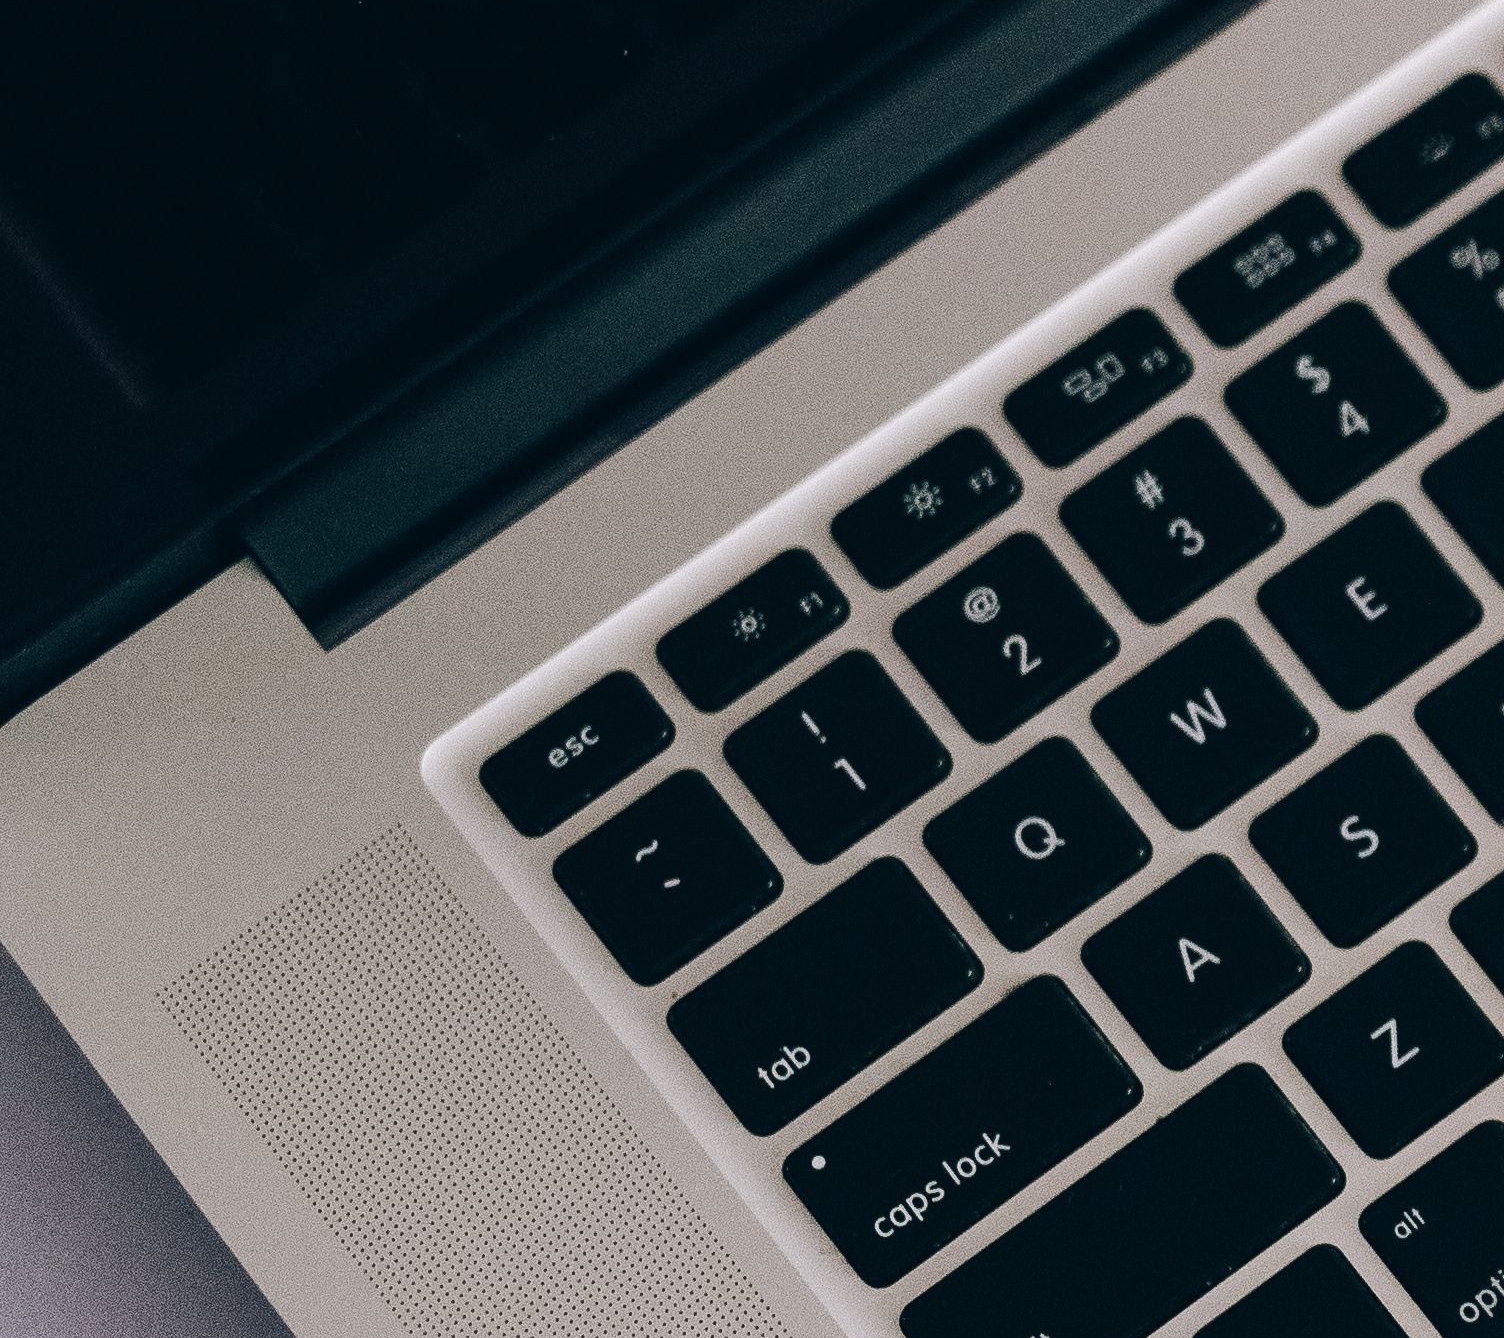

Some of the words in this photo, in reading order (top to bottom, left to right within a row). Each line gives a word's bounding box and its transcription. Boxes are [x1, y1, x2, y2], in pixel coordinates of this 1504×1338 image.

[1452, 239, 1500, 278] %
[1296, 355, 1330, 393] $
[1339, 402, 1370, 437] 4
[1134, 469, 1164, 509] #
[1168, 517, 1204, 557] 3
[964, 587, 1000, 623] @
[1346, 577, 1388, 620] E
[1002, 635, 1042, 675] 2
[1170, 688, 1226, 744] W
[548, 725, 599, 769] esc
[834, 759, 867, 790] 1
[1014, 817, 1065, 860] Q
[1340, 815, 1380, 859] S
[1177, 937, 1221, 983] A
[1370, 1018, 1420, 1069] Z
[758, 1043, 812, 1089] tab
[873, 1181, 946, 1239] caps
[942, 1133, 1010, 1185] lock
[1394, 1207, 1425, 1240] alt
